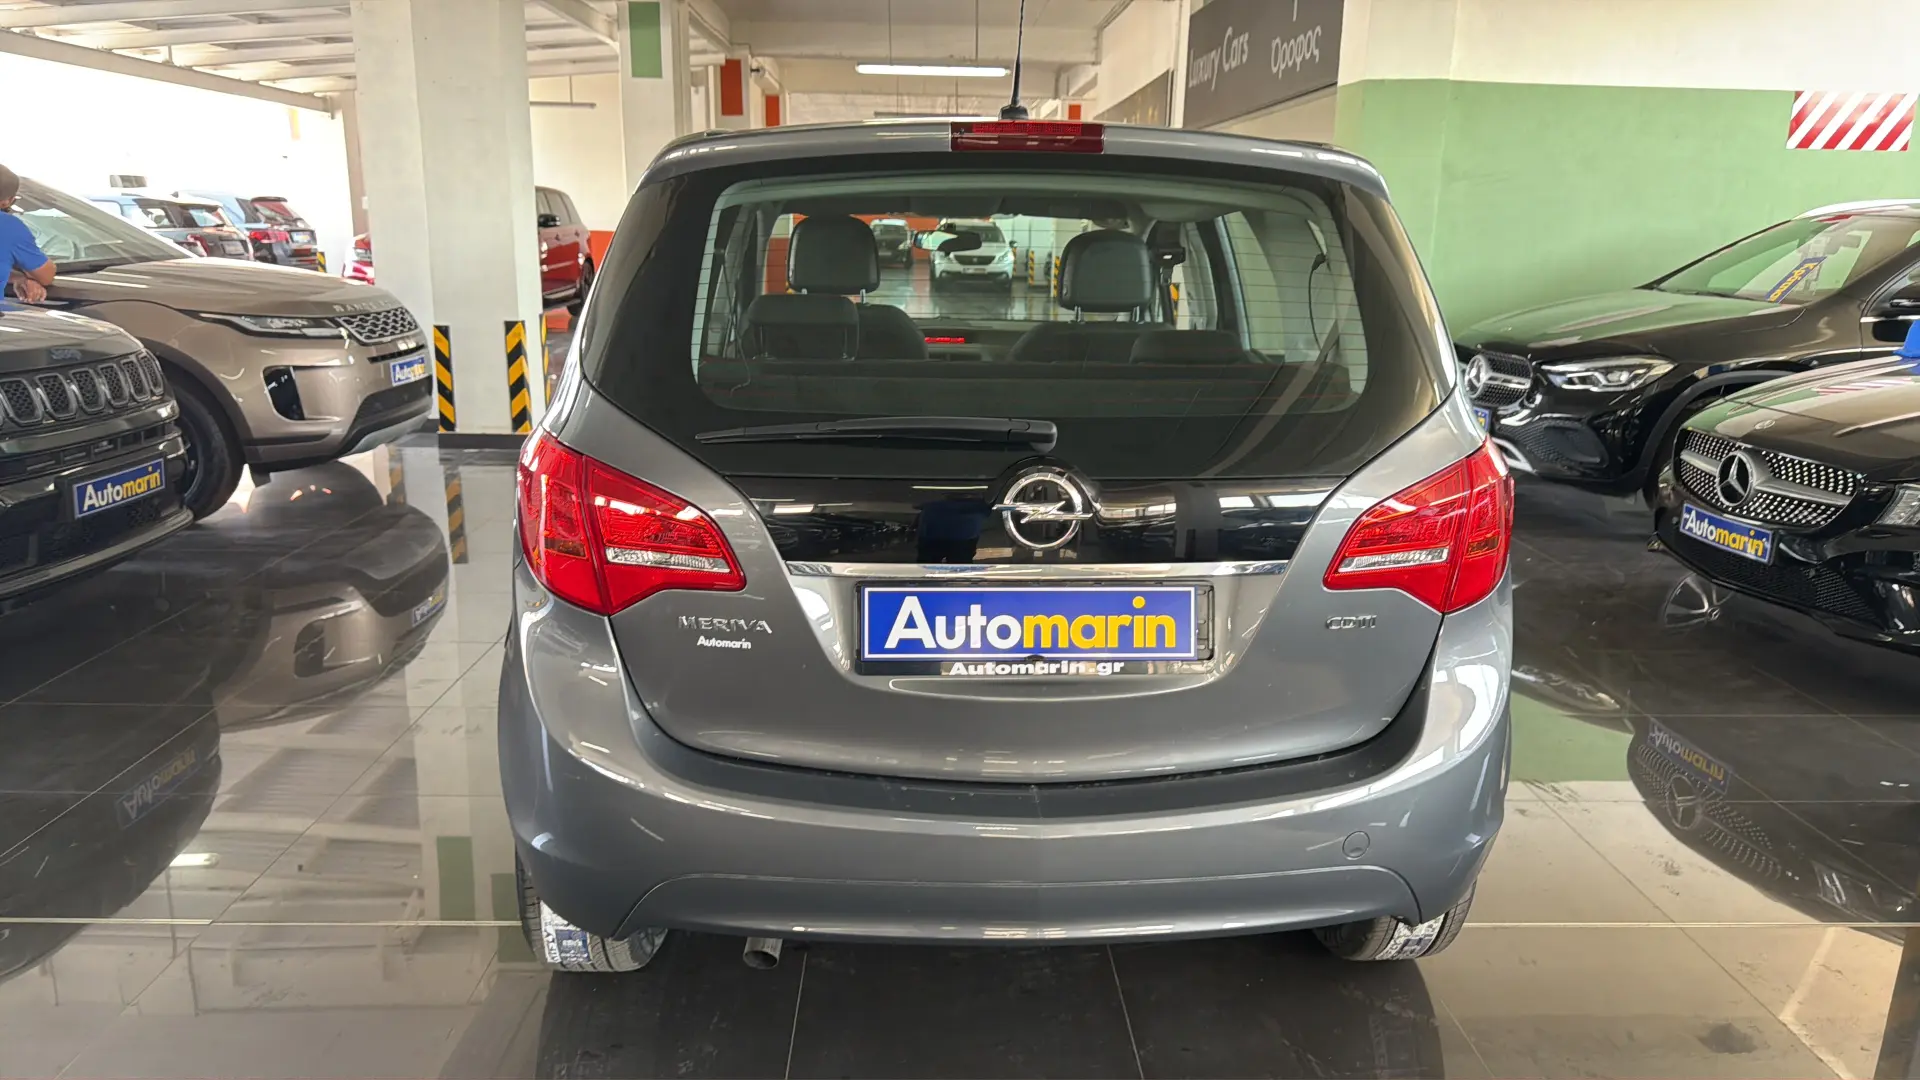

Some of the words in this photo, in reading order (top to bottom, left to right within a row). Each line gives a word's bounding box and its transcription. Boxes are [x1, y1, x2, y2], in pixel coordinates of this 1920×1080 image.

[1188, 46, 1221, 92] Luxury
[1222, 26, 1249, 72] Cars
[82, 466, 161, 512] Automarin
[1684, 509, 1764, 557] Automarin
[678, 615, 773, 634] MERIVA
[697, 635, 752, 650] Automarin
[884, 595, 1177, 649] Automarin
[949, 659, 1125, 677] Automarin.gr
